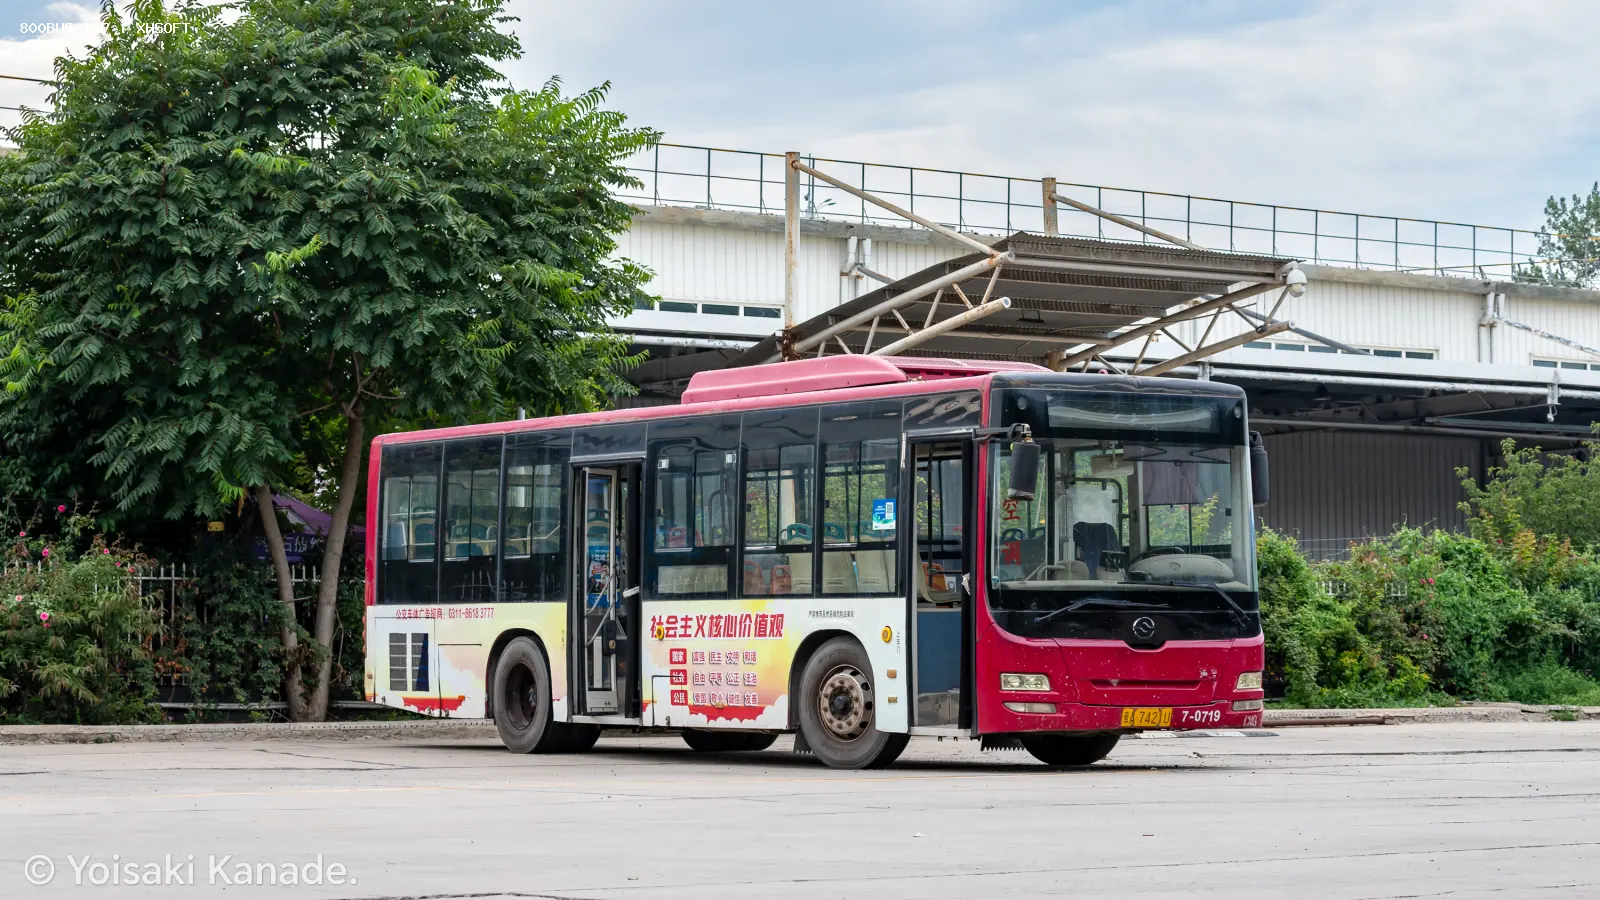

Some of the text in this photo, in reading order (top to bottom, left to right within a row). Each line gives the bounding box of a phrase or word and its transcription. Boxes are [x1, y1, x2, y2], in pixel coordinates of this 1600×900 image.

[650, 613, 785, 639] 社会主义核心价值观
[672, 651, 757, 662] 国家 富强 民主 文明 和谐
[672, 672, 757, 683] 社会 自由 平等 公正 法治
[673, 692, 685, 704] 公民
[694, 693, 707, 704] 爱国
[728, 693, 741, 704] 诚信
[745, 693, 758, 704] 友善
[1181, 709, 1221, 723] 7-0719
